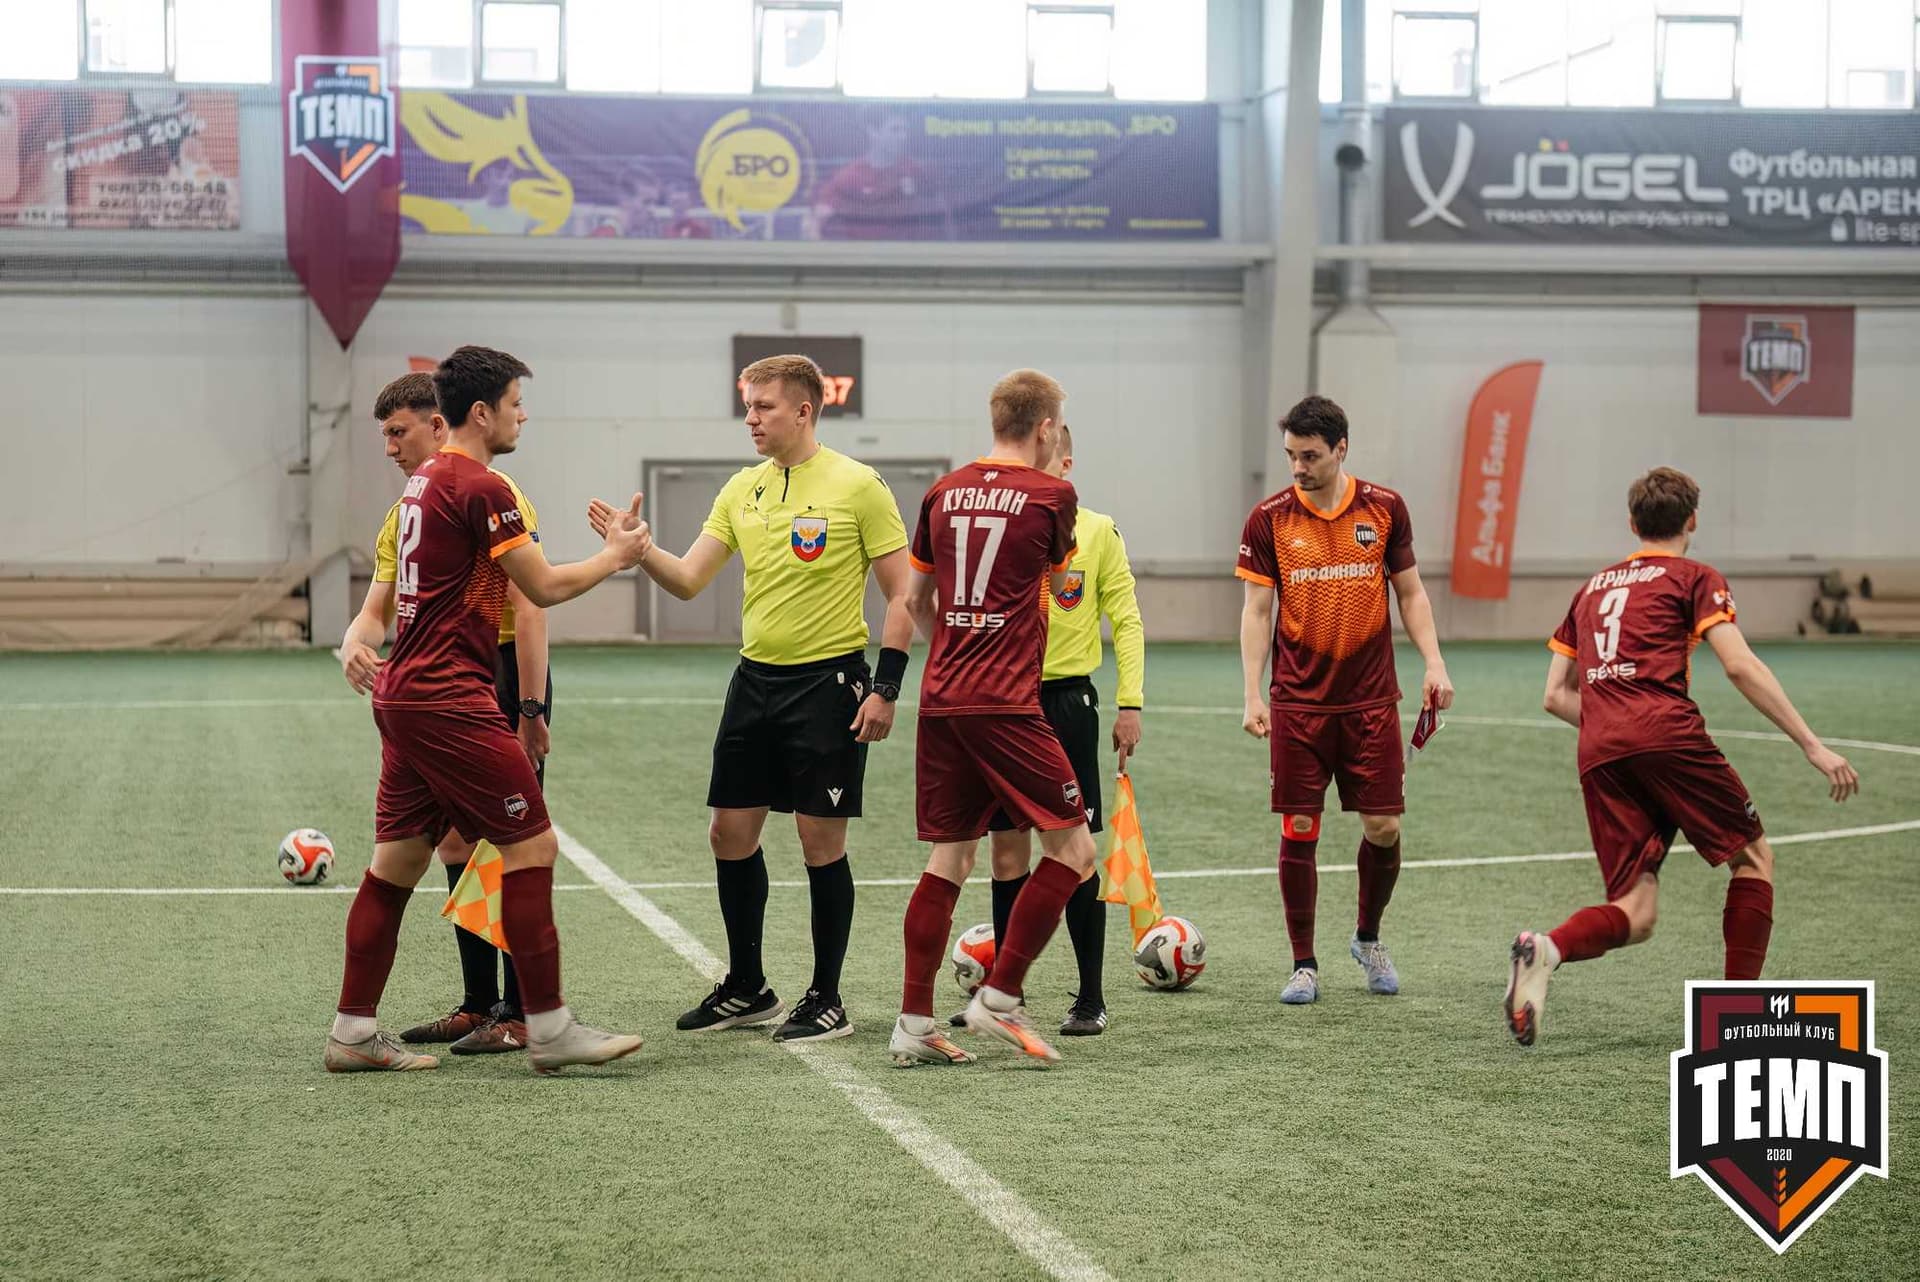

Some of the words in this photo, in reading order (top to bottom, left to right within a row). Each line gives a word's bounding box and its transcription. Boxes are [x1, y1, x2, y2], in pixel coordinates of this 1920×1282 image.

[300, 94, 386, 141] ТЕМП
[726, 154, 790, 178] .БРО
[1480, 138, 1729, 201] JÖGEL
[1728, 148, 1917, 184] Футбольная
[1742, 186, 1811, 220] ТРЦ
[942, 487, 1028, 515] КУЗЬКИН
[950, 516, 1008, 607] 17
[945, 611, 1006, 628] SEUS
[1593, 586, 1631, 663] 3
